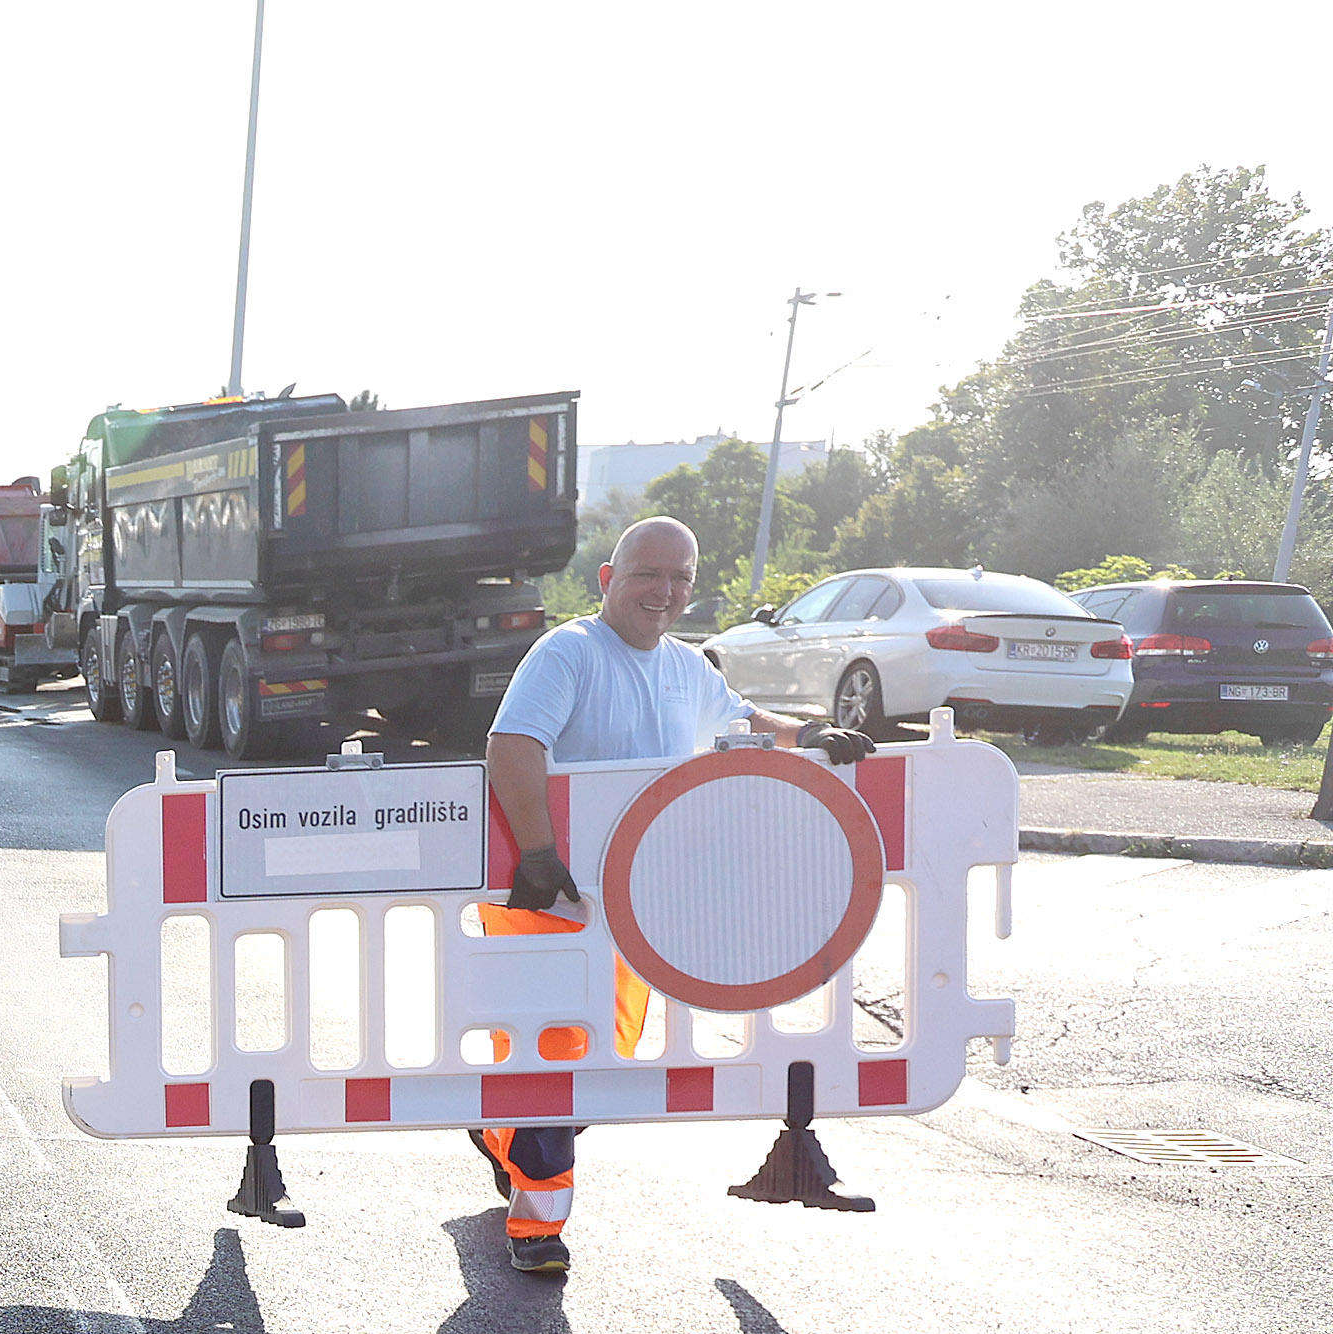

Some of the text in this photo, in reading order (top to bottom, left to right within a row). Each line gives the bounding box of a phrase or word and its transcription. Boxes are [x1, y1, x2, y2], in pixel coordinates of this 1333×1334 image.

[1228, 687, 1242, 697] NG
[239, 800, 469, 830] Osim vozila gradilišta
